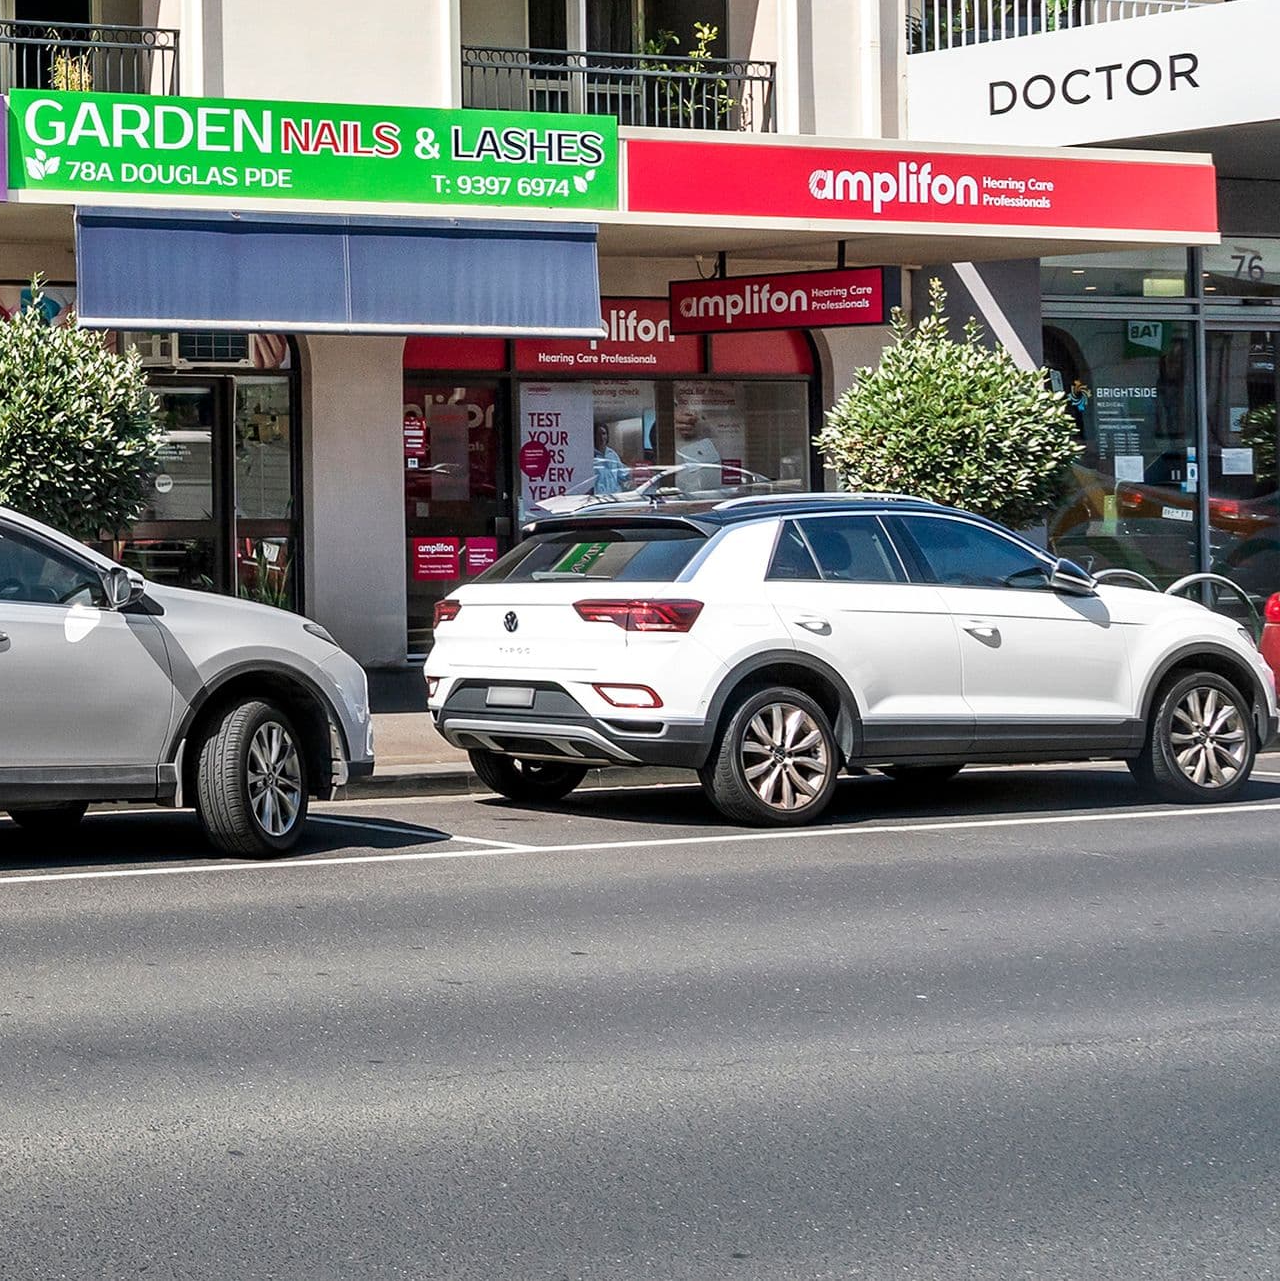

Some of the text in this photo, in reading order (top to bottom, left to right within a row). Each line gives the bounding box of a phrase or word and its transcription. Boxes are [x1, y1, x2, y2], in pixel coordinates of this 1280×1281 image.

[989, 52, 1200, 116] DOCTOR
[24, 99, 605, 167] GARDEN NAILS & LASHES
[65, 161, 293, 188] 78A DOUGLAS PDE
[431, 175, 570, 197] T: 9397 6974
[808, 161, 978, 213] amplifon
[982, 176, 1054, 193] Hearing Care
[982, 194, 1051, 209] Professionals
[1231, 255, 1264, 279] 76
[811, 284, 873, 299] Hearing Care
[679, 283, 808, 324] amplifon
[811, 298, 870, 312] Professionals
[538, 352, 657, 365] Hearing Care Professionals
[1096, 387, 1158, 398] BRIGHTSIDE
[528, 412, 561, 427] TEST
[528, 431, 569, 446] YOUR
[418, 543, 454, 554] amplifon
